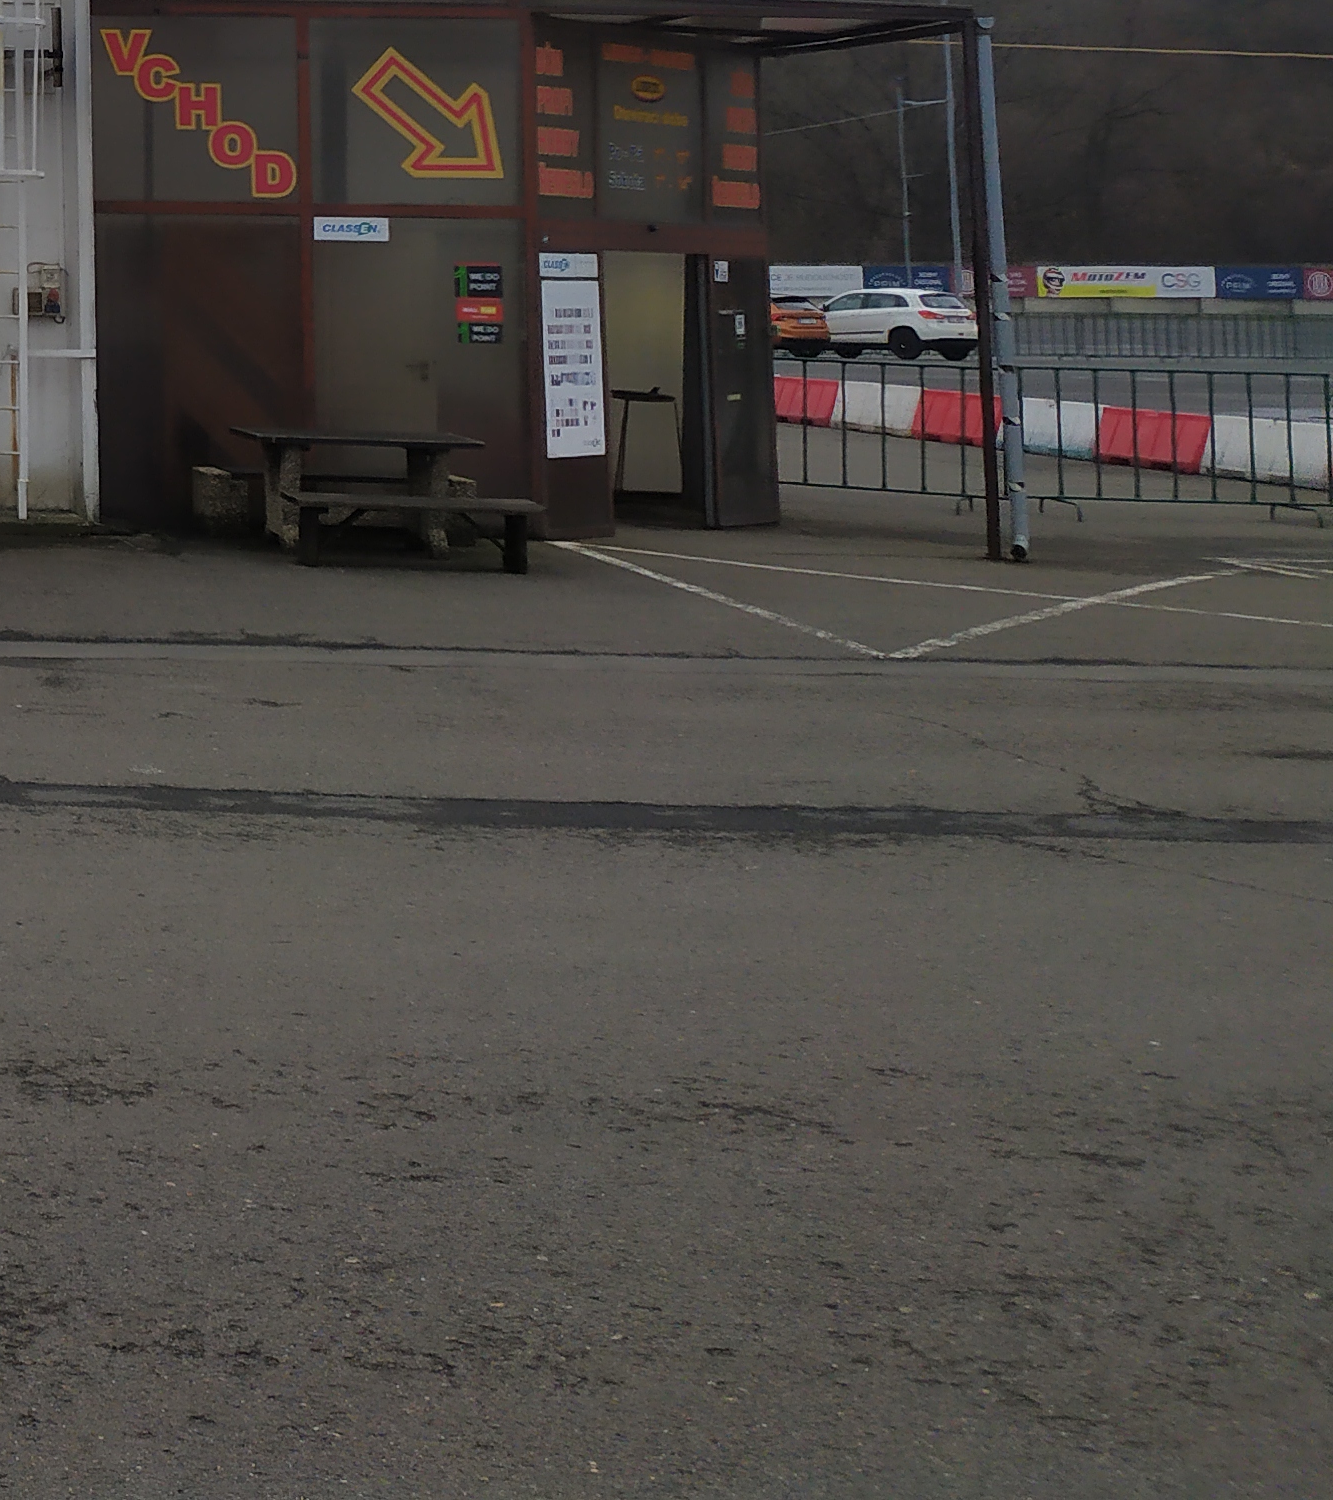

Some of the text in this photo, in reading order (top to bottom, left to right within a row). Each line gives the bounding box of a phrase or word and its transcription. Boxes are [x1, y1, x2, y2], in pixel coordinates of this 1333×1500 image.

[98, 28, 298, 199] VCHOD
[321, 222, 380, 236] CLASSEN
[1161, 272, 1201, 288] CSG
